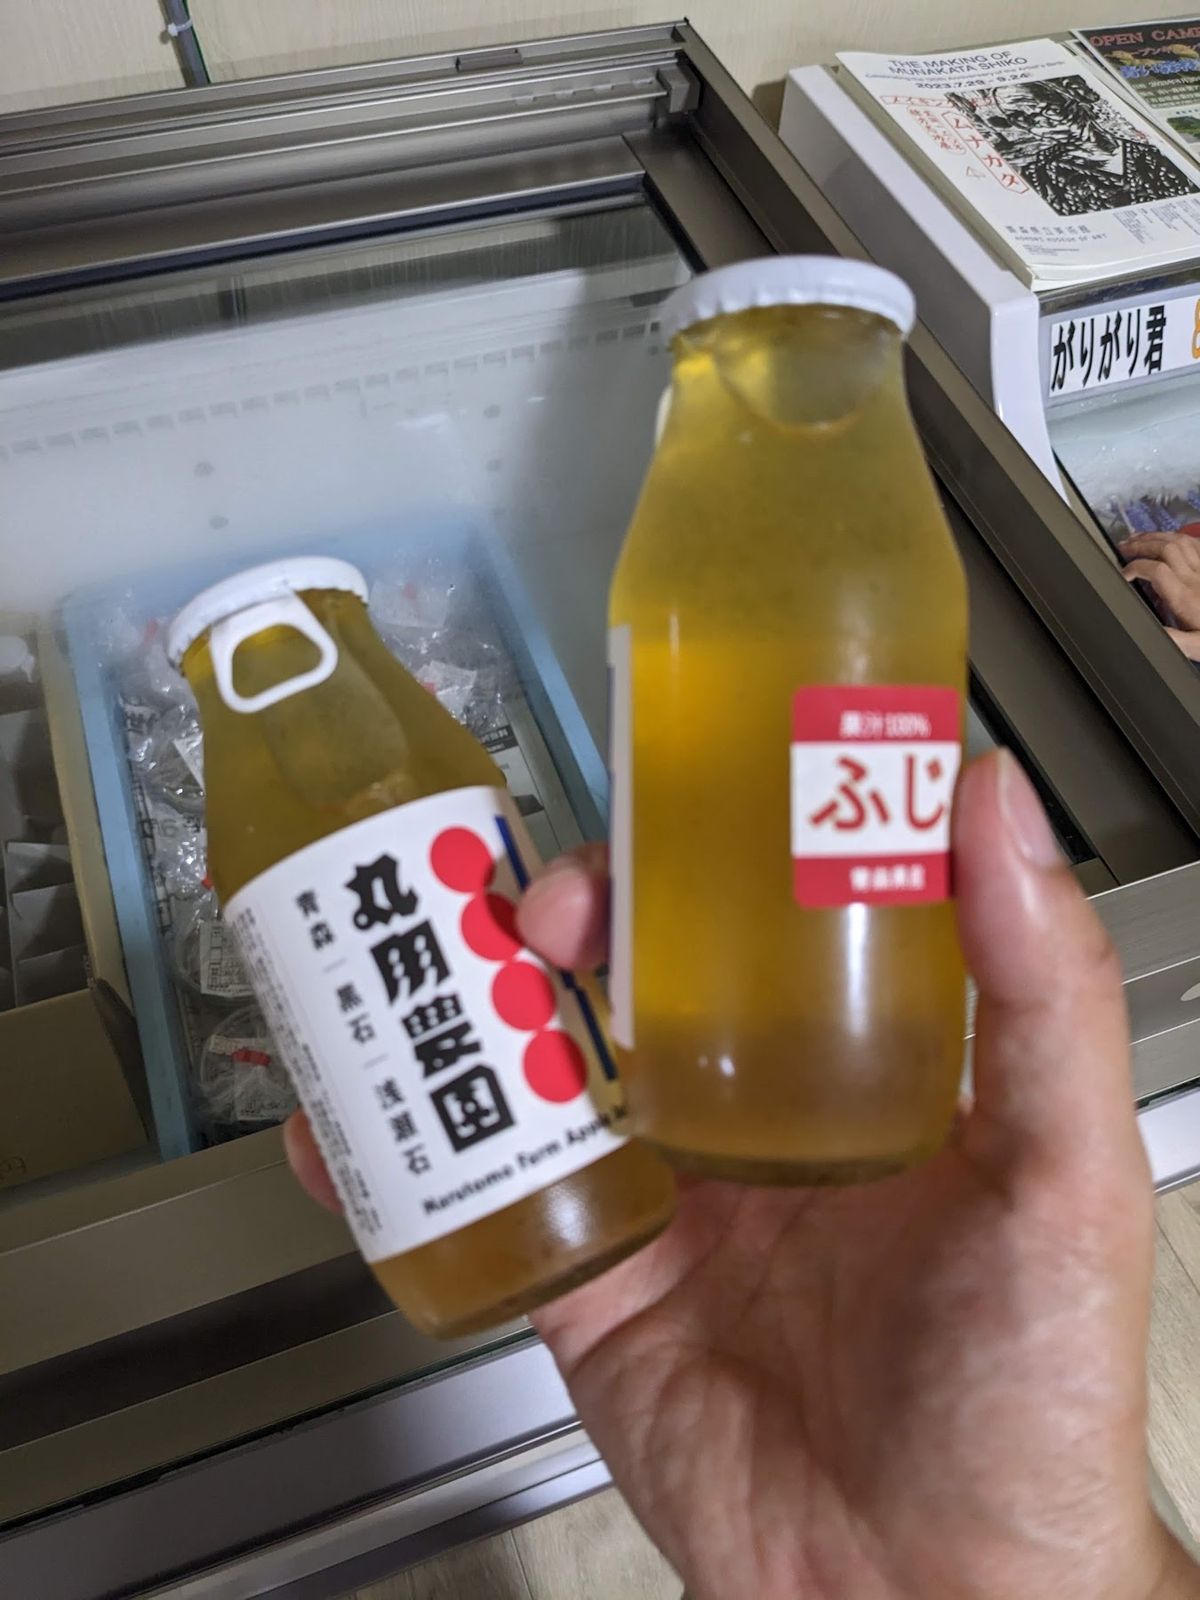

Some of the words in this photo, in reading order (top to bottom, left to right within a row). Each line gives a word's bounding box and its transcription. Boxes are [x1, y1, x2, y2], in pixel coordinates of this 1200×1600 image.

[1090, 32, 1144, 48] OPEN
[887, 64, 978, 76] MUNAKATA
[978, 57, 1028, 71] SHIKO
[888, 59, 921, 69] THE
[923, 54, 988, 67] MAKING
[990, 50, 1012, 60] OF
[1051, 305, 1167, 392] がりがり君
[810, 752, 947, 832] ふじ
[517, 1140, 562, 1171] Farm
